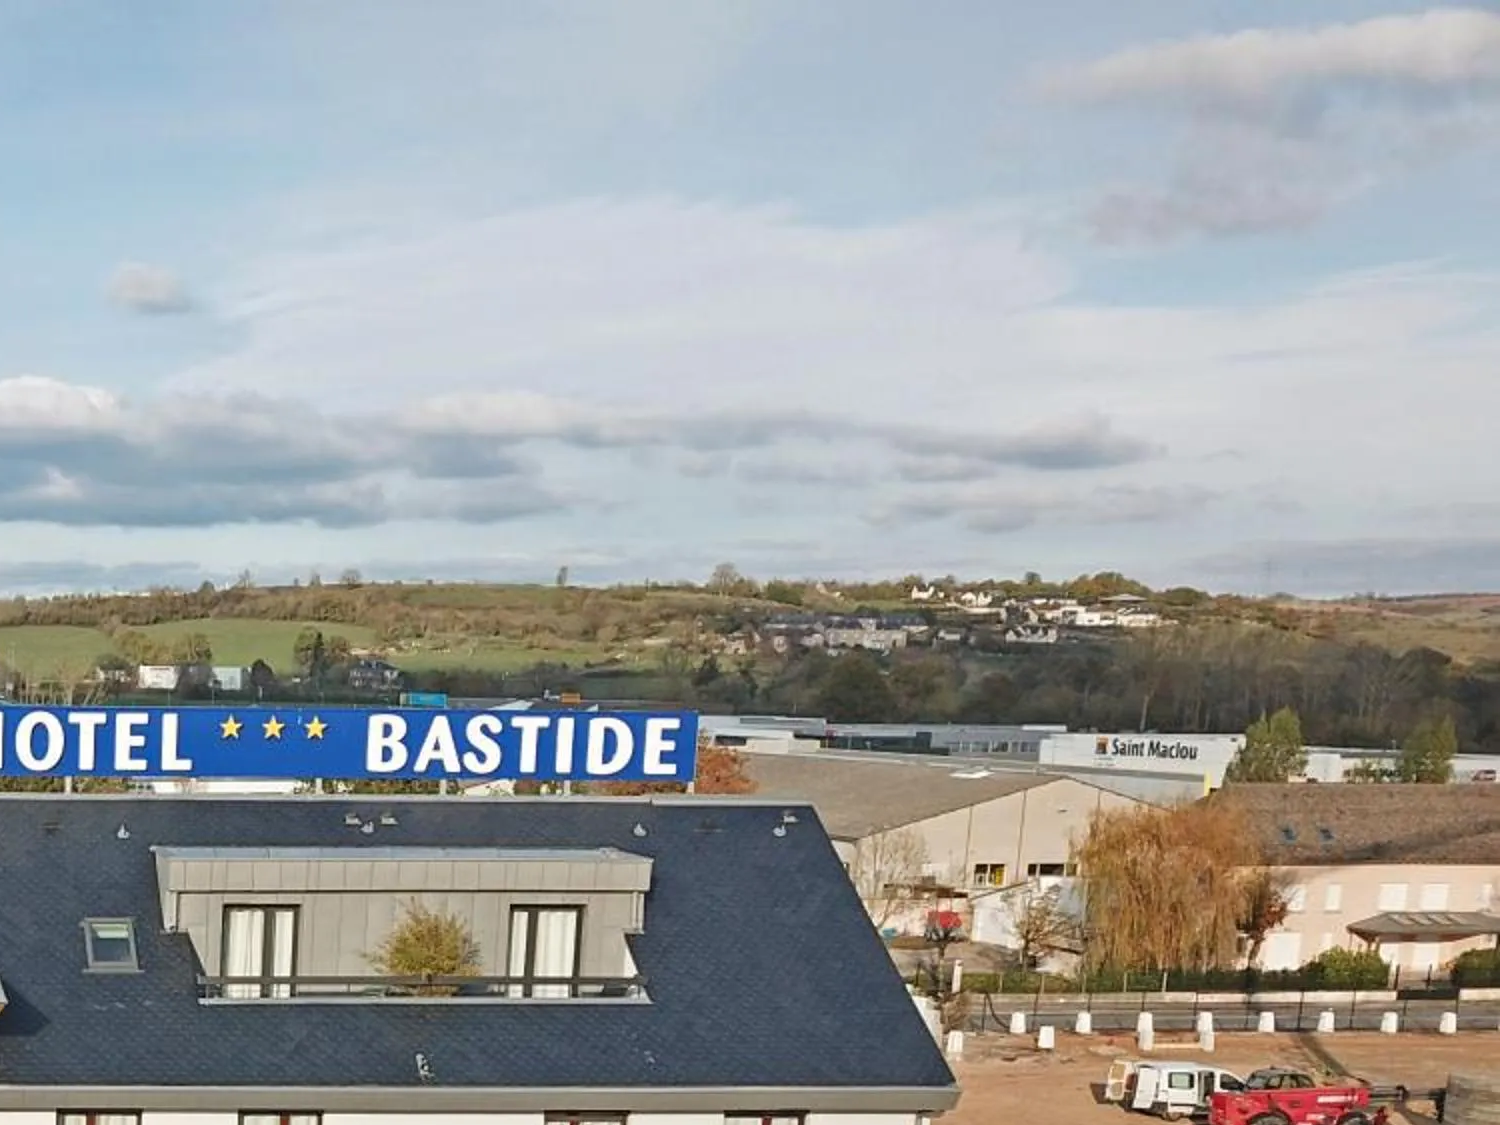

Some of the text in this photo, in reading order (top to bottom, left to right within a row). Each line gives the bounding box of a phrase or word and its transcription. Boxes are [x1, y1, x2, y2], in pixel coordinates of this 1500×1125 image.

[366, 713, 681, 776] BASTIDE
[1111, 737, 1198, 760] Saint Maclou
